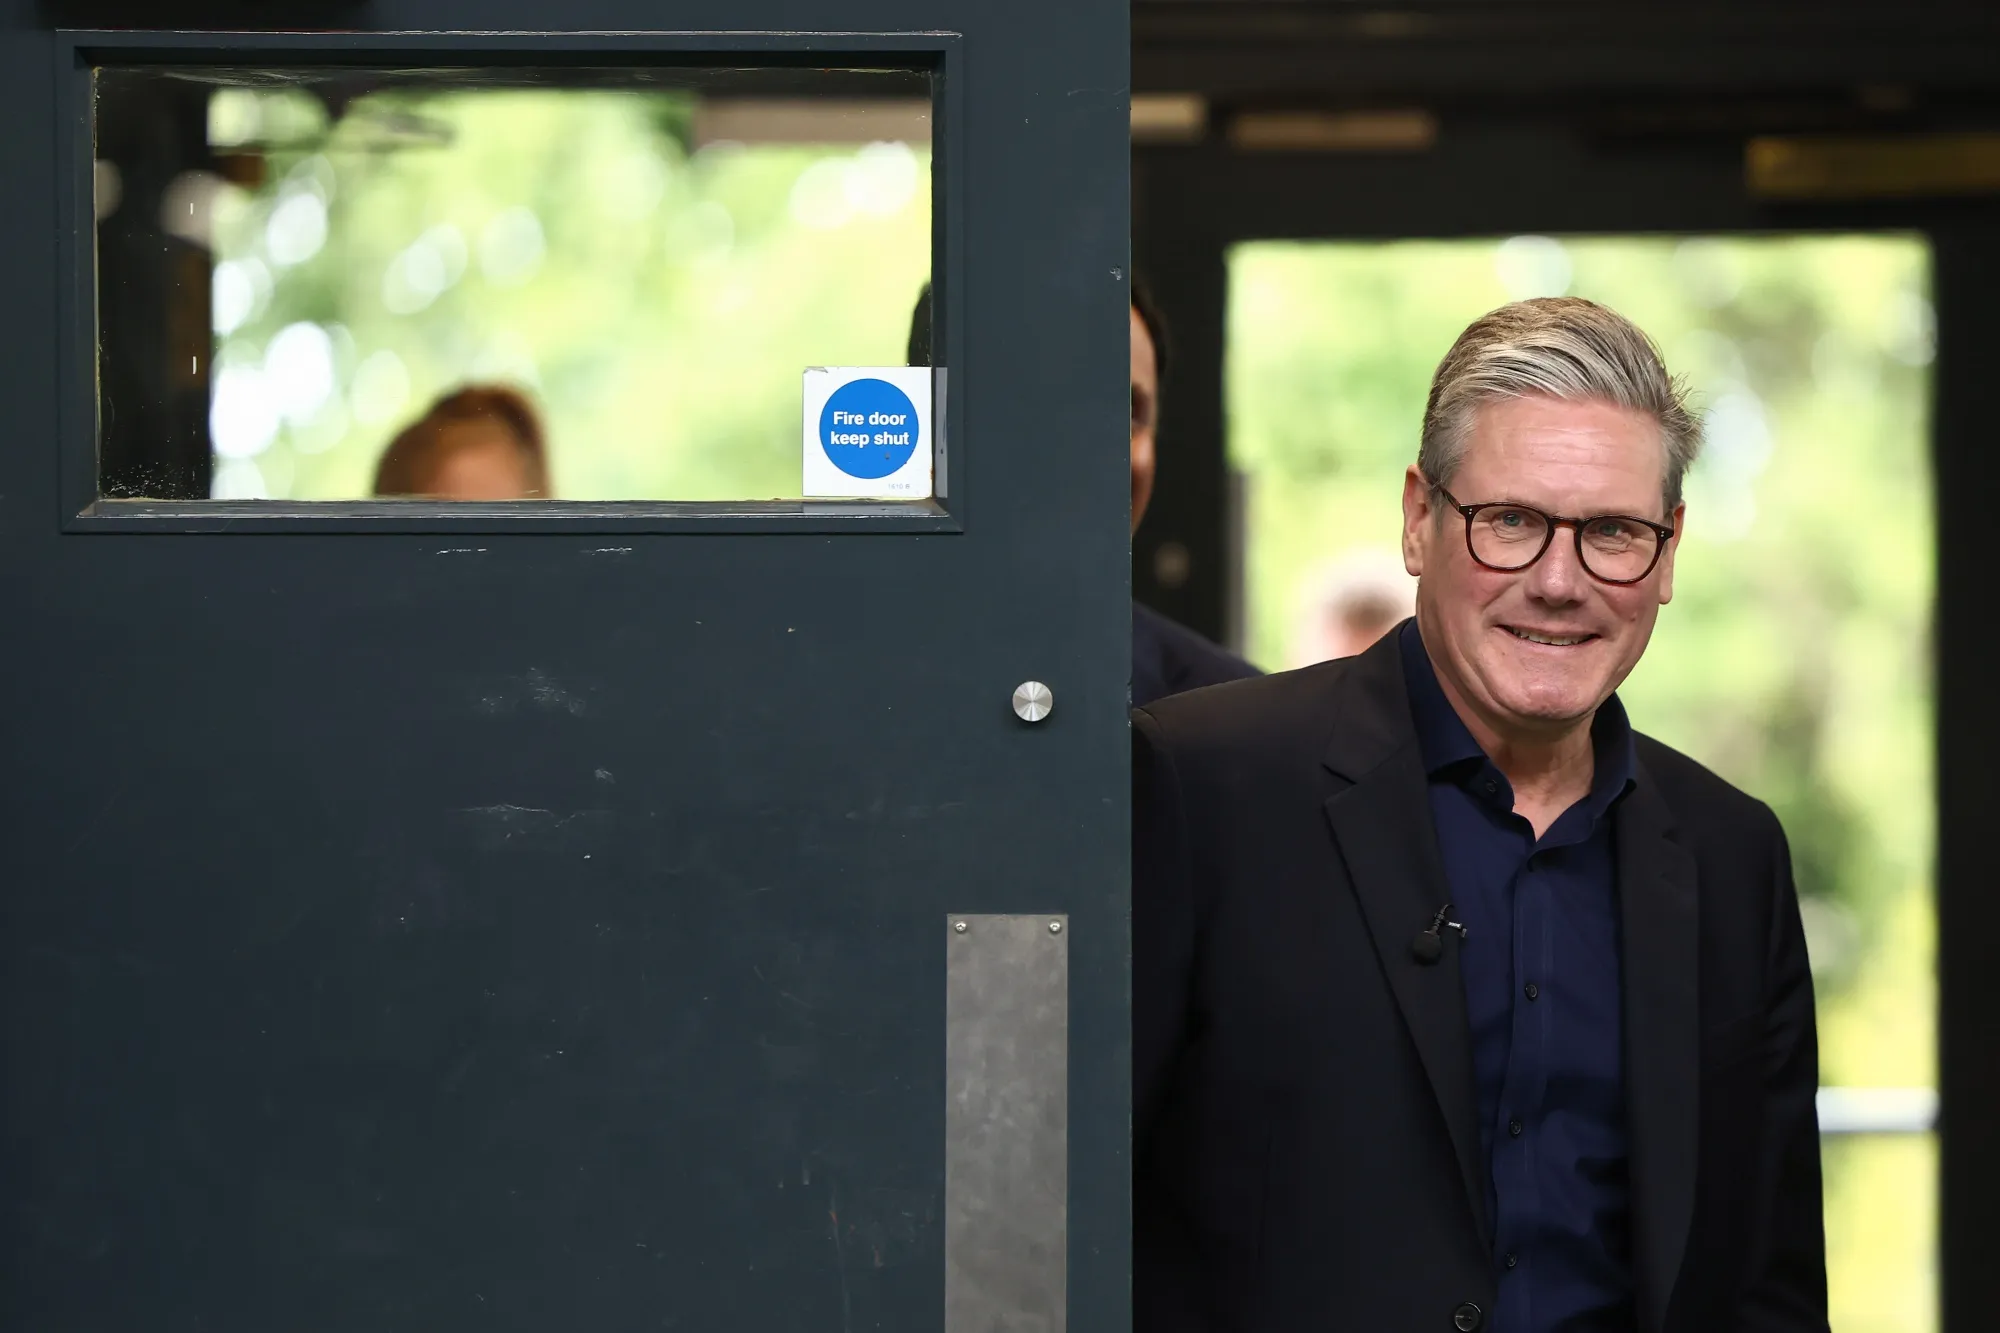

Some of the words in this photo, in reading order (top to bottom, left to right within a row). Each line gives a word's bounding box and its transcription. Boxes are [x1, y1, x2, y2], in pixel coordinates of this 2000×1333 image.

[833, 411, 865, 425] Fire
[868, 411, 907, 426] door
[830, 431, 870, 448] keep
[873, 431, 909, 445] shut
